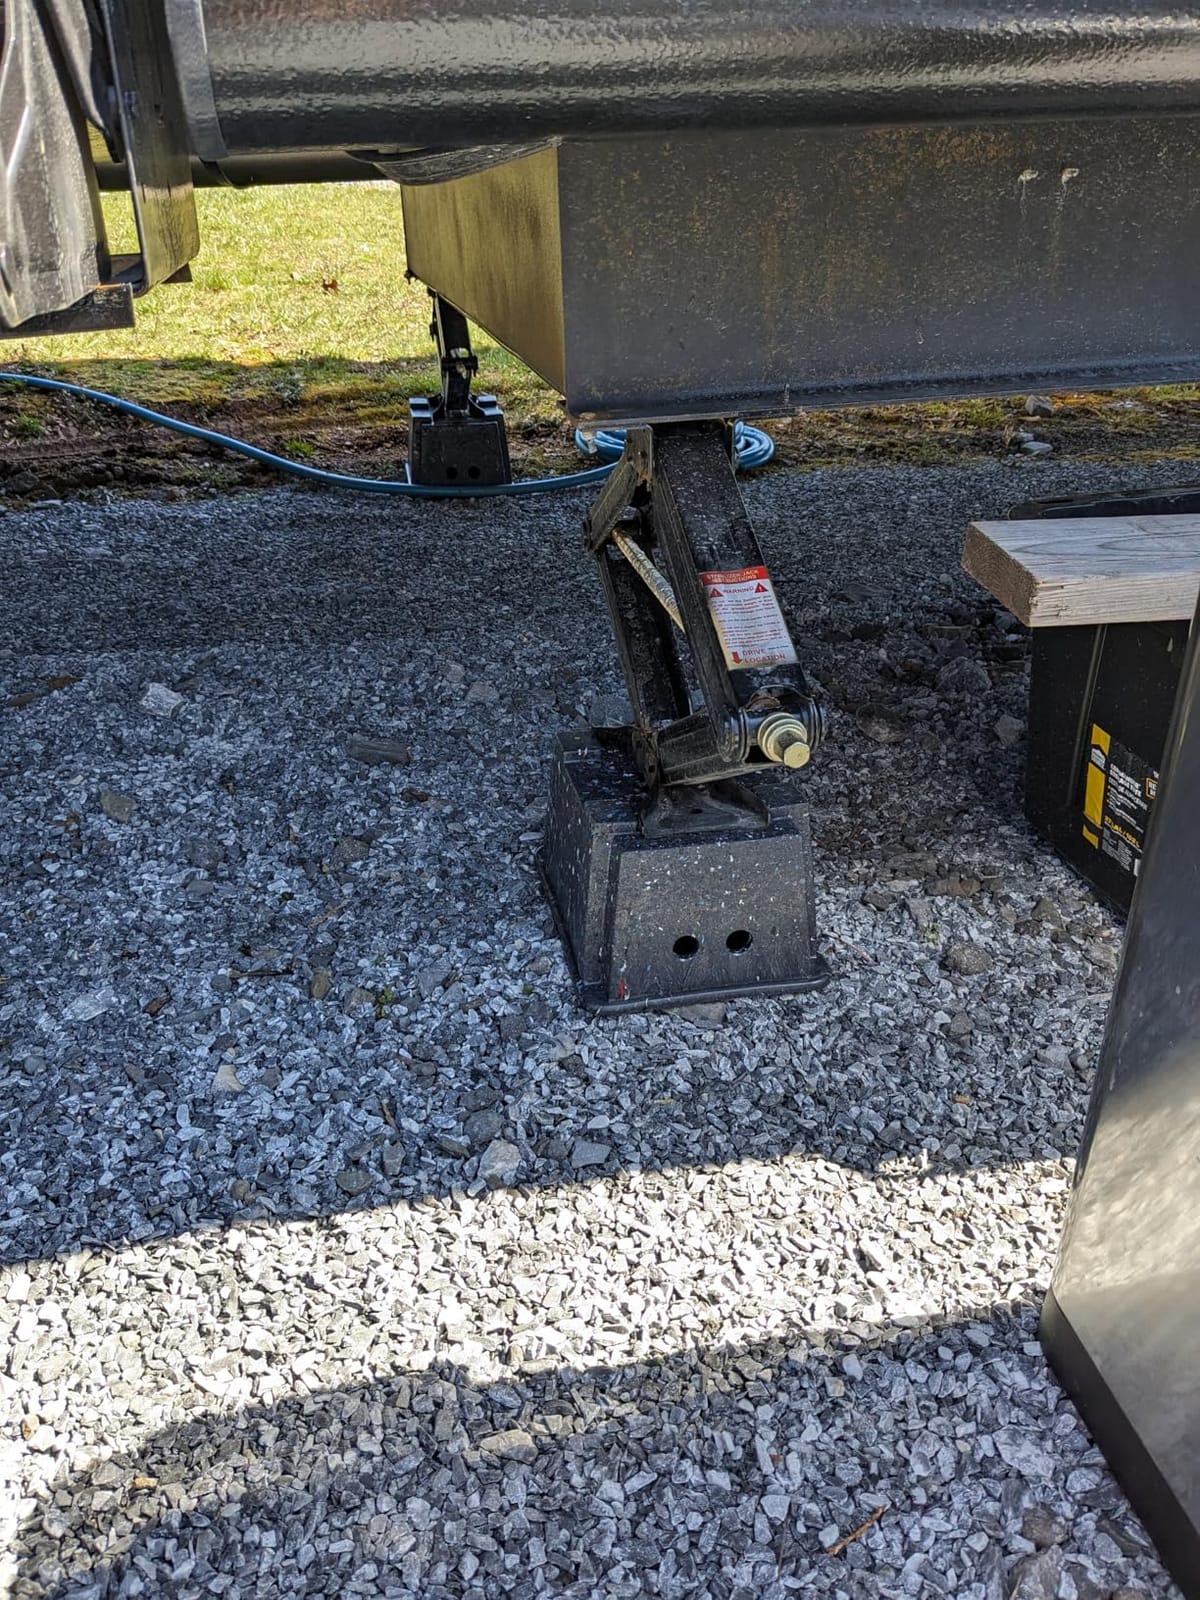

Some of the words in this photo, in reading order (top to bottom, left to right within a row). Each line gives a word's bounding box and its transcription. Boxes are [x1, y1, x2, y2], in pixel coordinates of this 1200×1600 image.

[723, 586, 754, 594] WARNING
[742, 648, 767, 656] DRIVE
[744, 653, 786, 663] LOCATION
